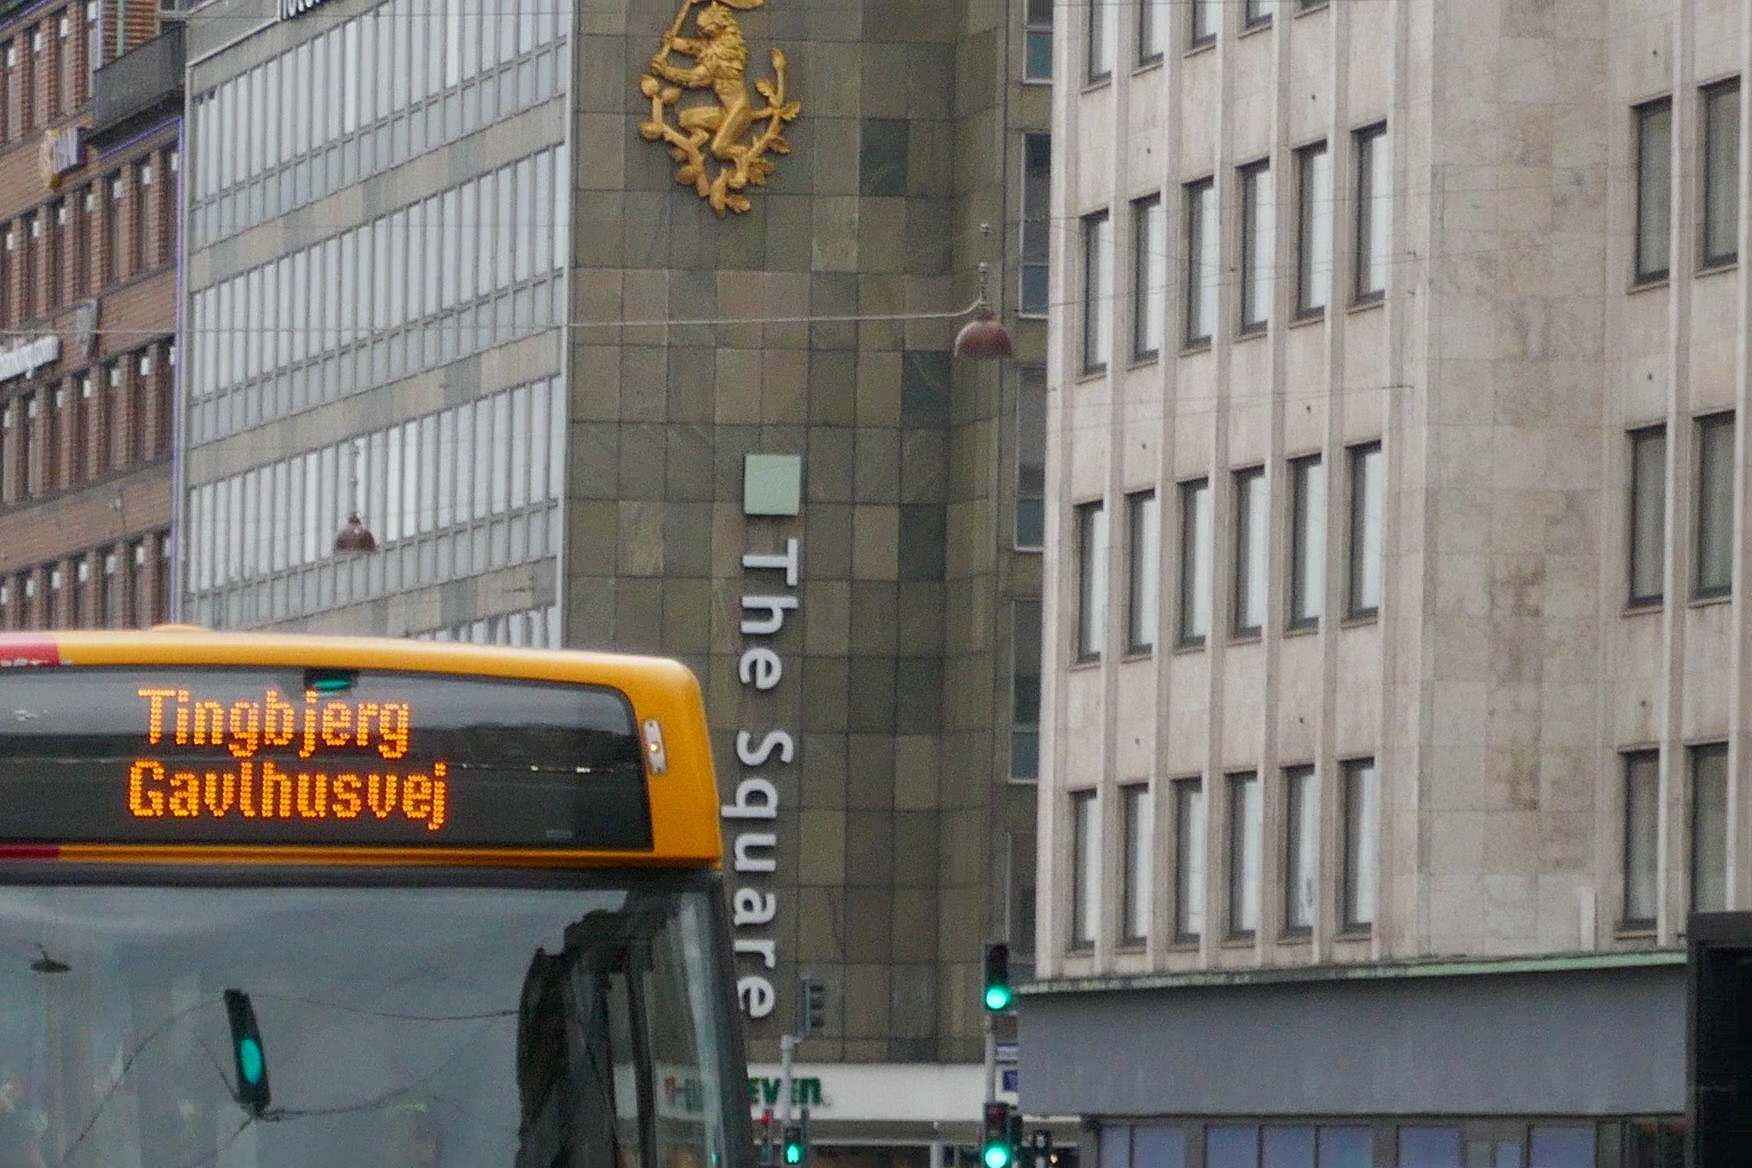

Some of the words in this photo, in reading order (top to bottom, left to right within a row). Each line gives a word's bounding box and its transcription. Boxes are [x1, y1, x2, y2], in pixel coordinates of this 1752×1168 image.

[738, 538, 798, 690] The
[138, 687, 411, 757] Tingbjerg
[128, 758, 447, 830] Gavlhusvej
[721, 730, 794, 1019] Square
